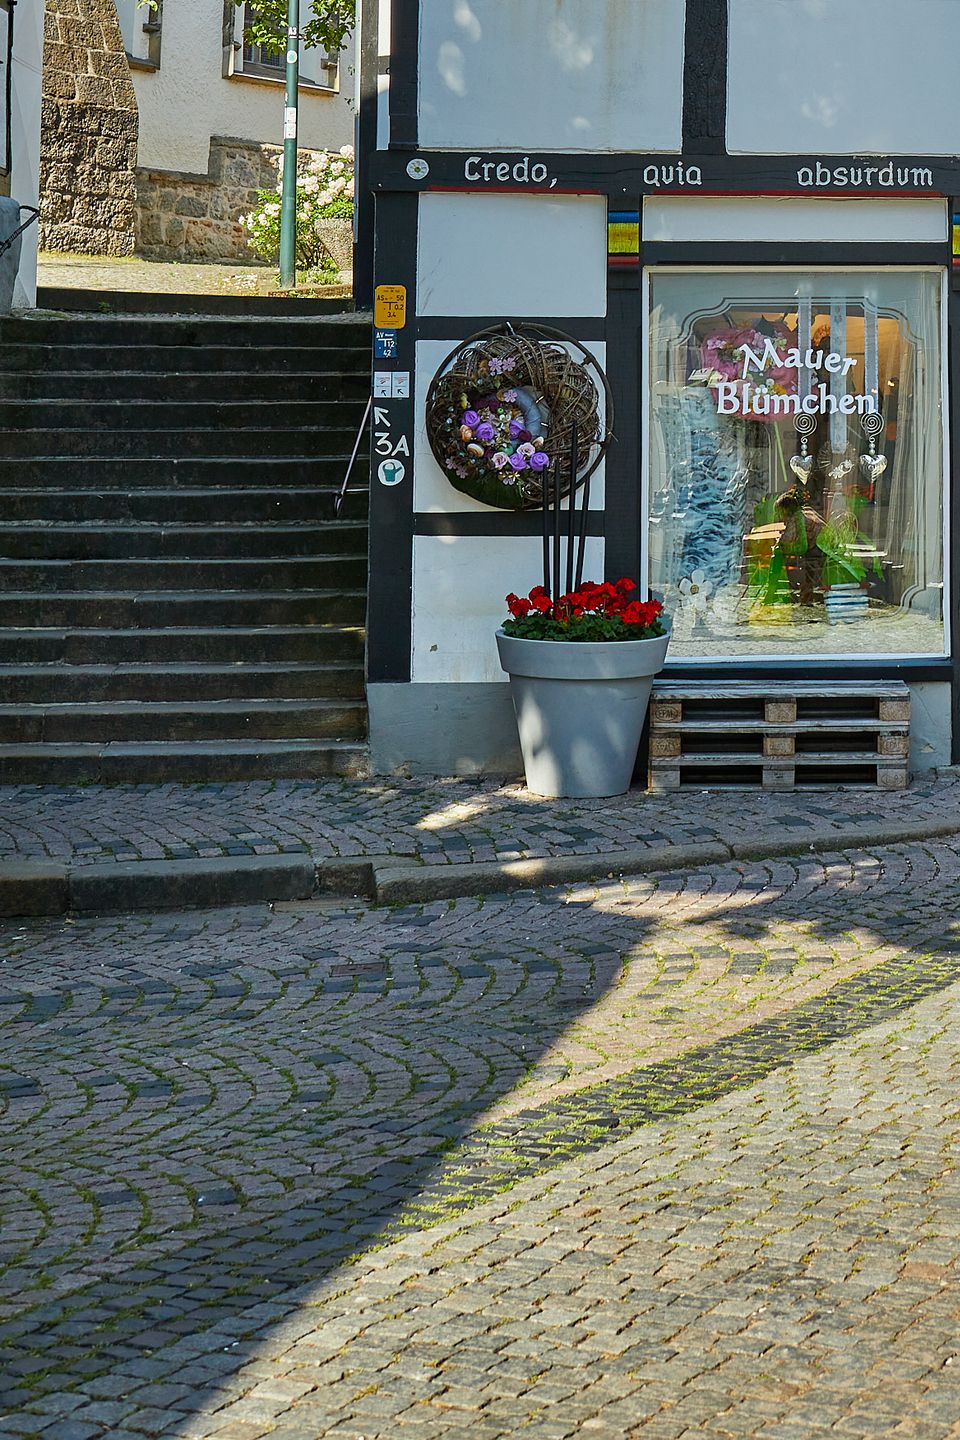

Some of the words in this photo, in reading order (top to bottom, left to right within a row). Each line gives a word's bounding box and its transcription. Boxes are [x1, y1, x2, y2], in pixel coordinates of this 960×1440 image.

[464, 156, 558, 189] Credo,
[643, 160, 703, 187] quia
[796, 160, 934, 187] absurdum
[739, 338, 858, 380] Mauer
[716, 381, 879, 415] Blümchen
[374, 431, 410, 457] 3A
